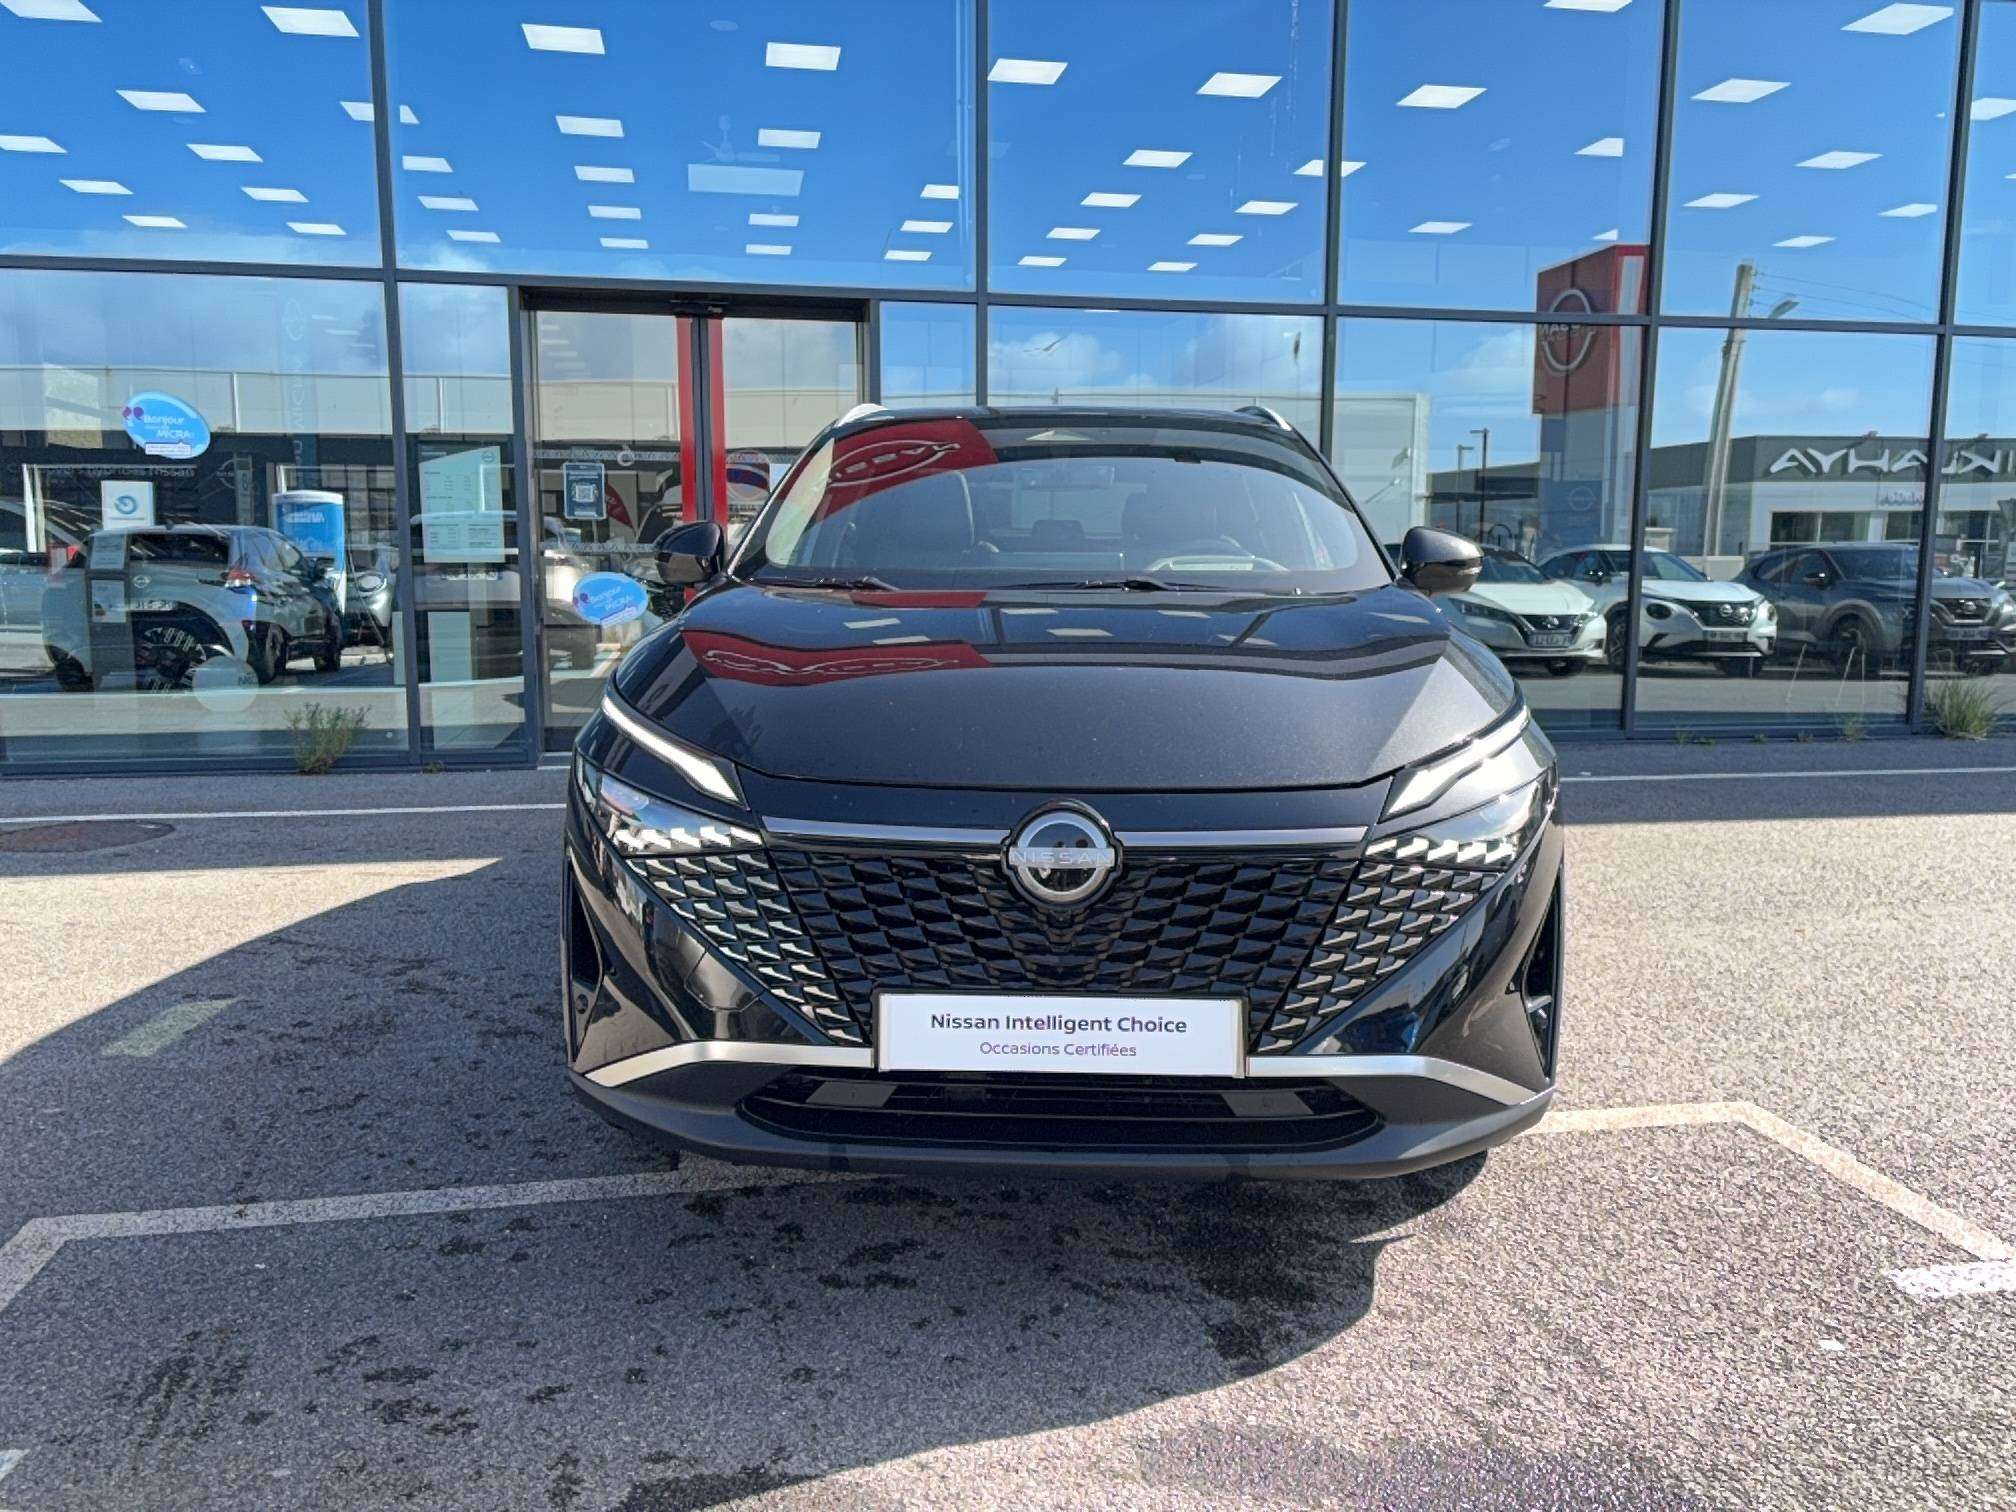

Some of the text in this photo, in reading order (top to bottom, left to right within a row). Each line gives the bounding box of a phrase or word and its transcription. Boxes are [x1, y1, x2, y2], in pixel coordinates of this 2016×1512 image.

[1012, 851, 1108, 864] NISSAN
[931, 1013, 1188, 1034] Nissan Intelligent Choice
[979, 1041, 1138, 1057] Occasions Certifiées
